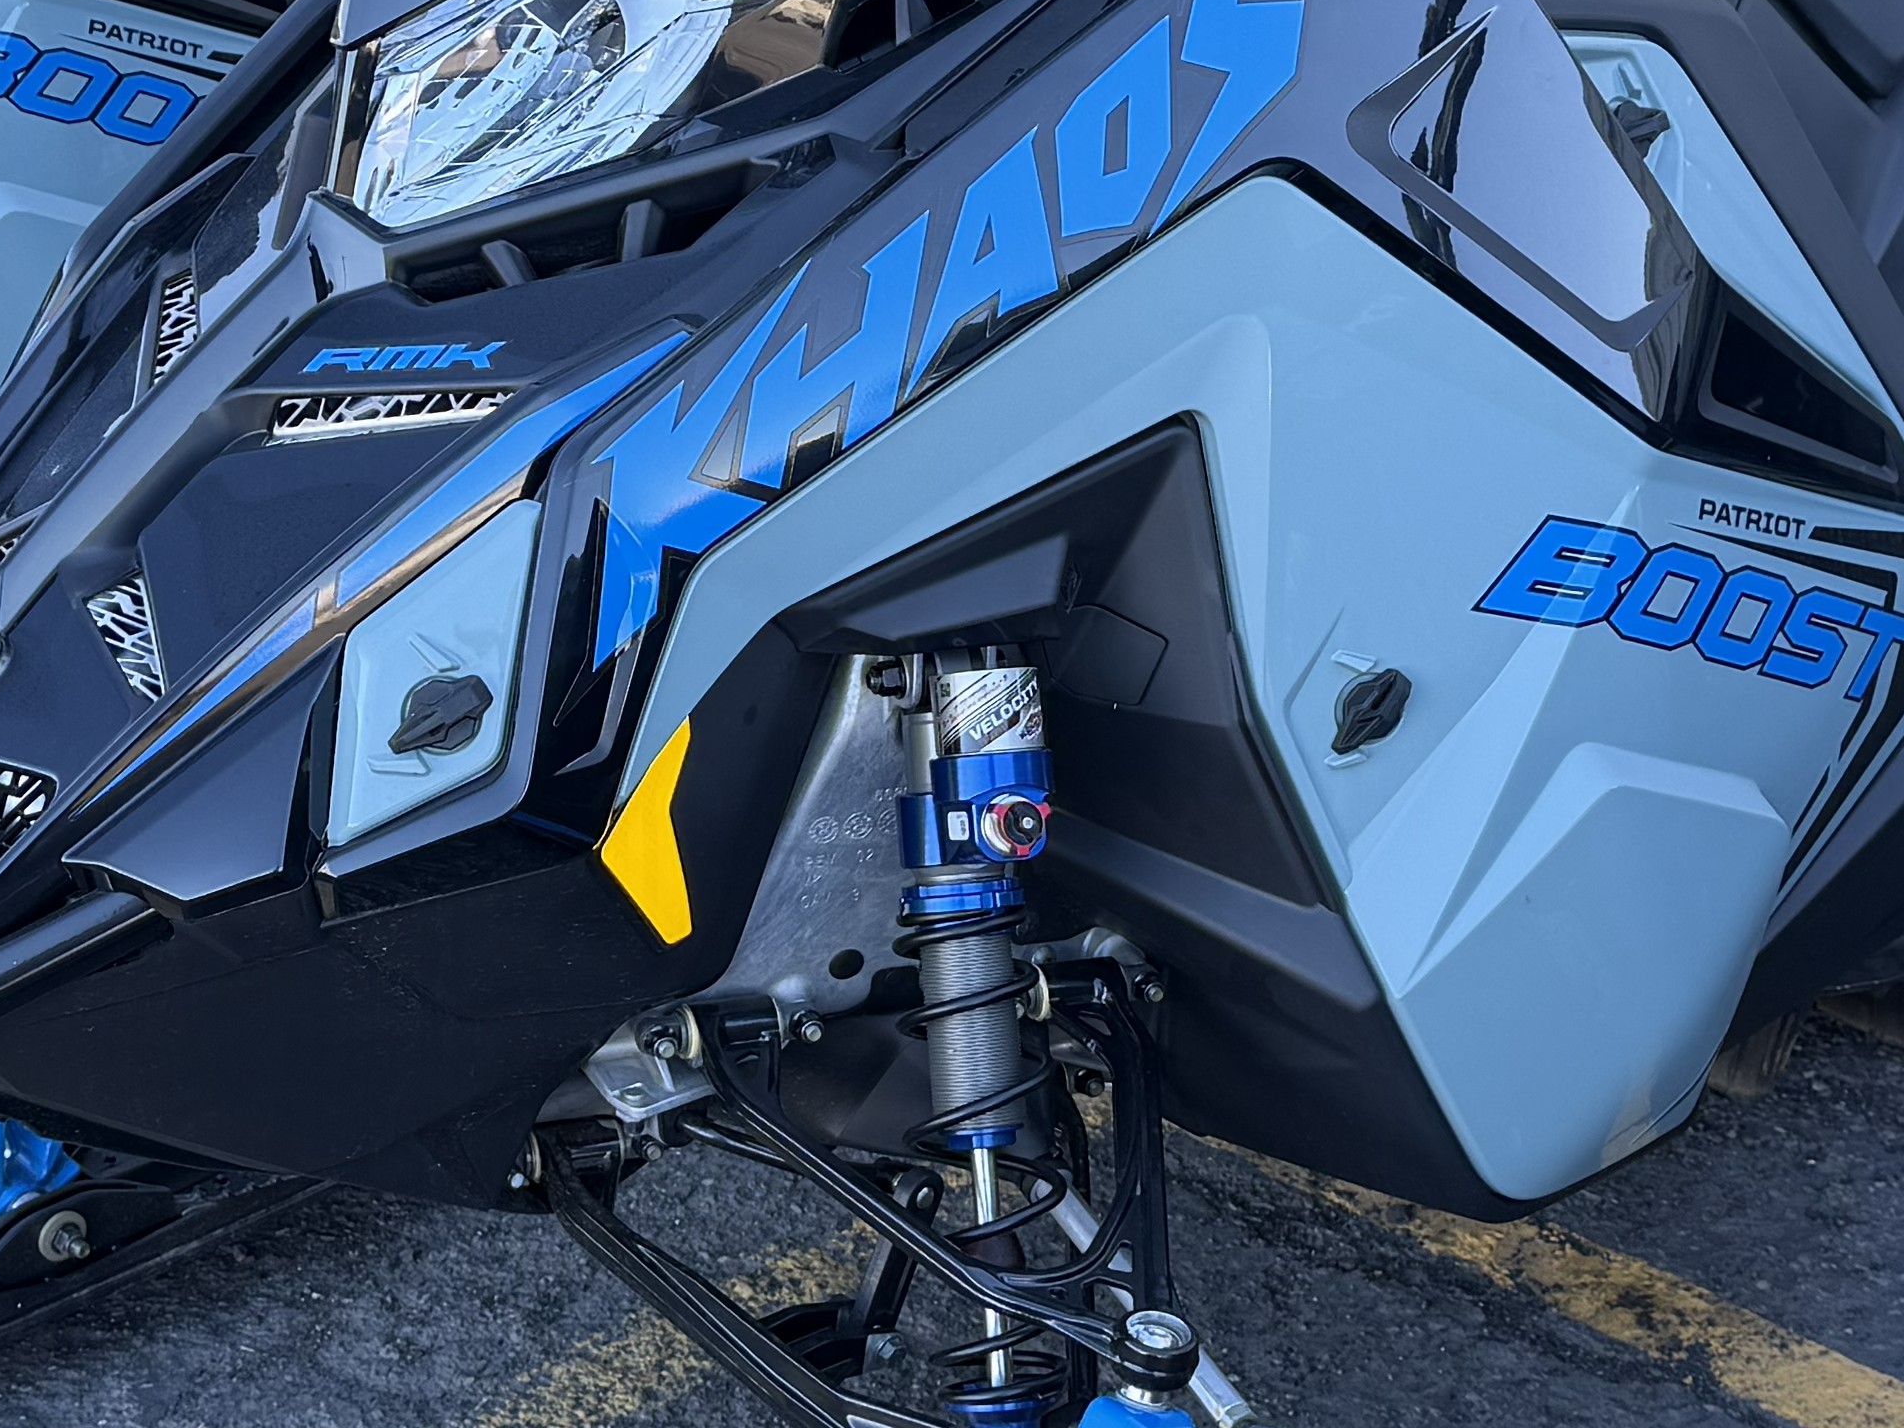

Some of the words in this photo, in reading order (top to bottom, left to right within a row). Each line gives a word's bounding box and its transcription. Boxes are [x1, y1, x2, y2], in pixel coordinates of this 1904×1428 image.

[88, 19, 204, 59] PATRIOT
[302, 341, 508, 373] RMK
[1698, 498, 1808, 540] PATRIOT
